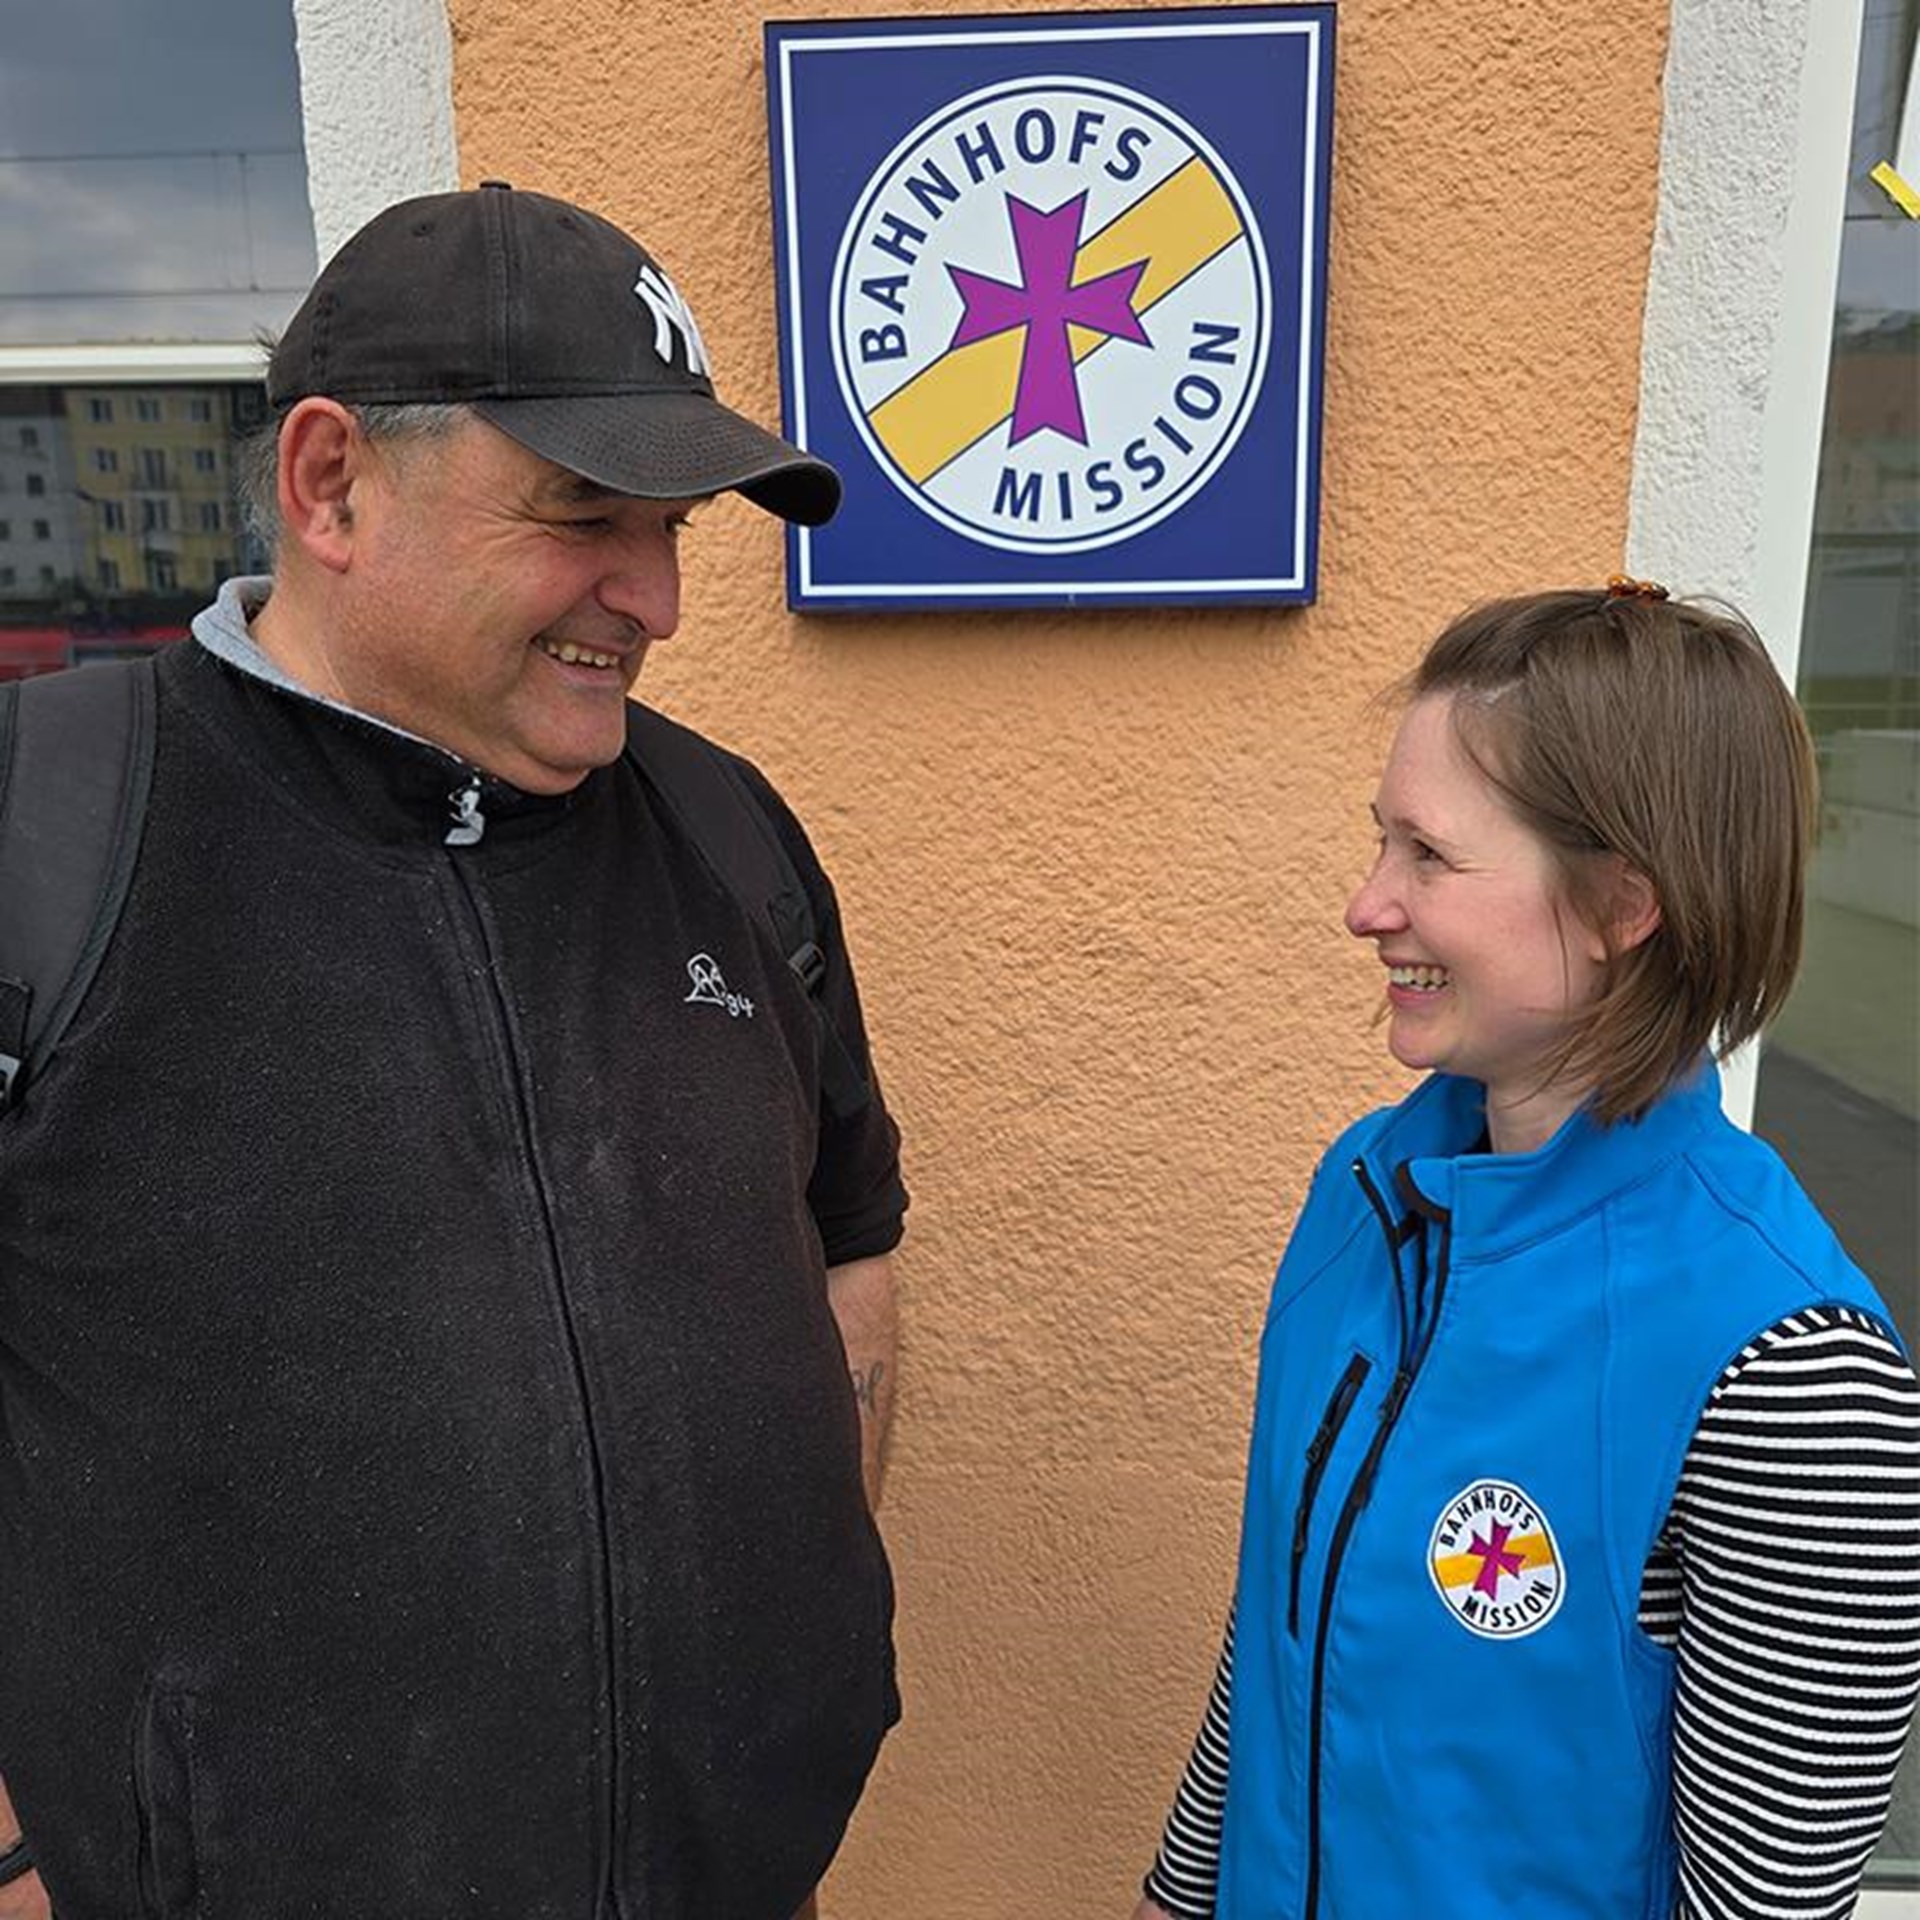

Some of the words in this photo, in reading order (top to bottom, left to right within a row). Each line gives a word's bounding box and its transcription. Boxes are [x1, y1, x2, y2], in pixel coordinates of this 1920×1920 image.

[860, 108, 1151, 363] BAHNHOFS
[992, 322, 1240, 522] MISSION
[1440, 1490, 1534, 1547] BAHNHOFS
[1461, 1580, 1553, 1627] MISSION
